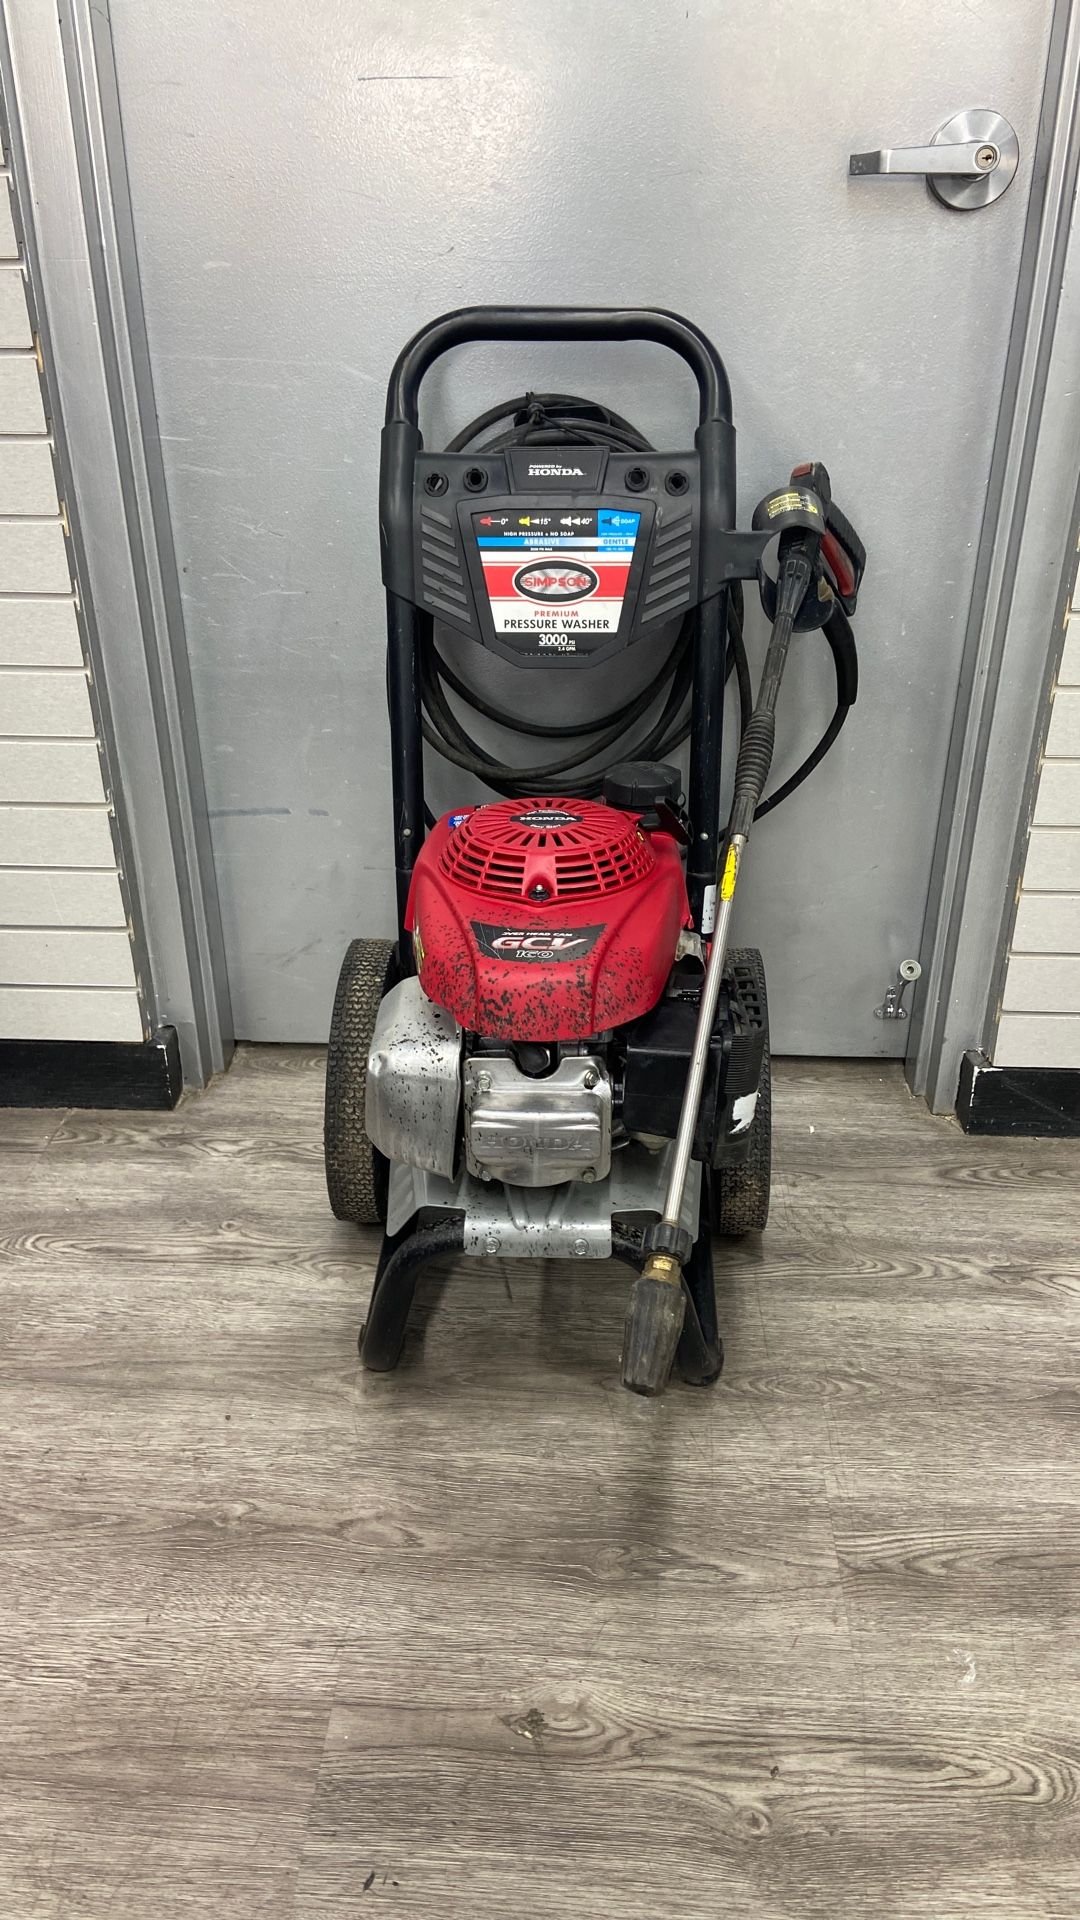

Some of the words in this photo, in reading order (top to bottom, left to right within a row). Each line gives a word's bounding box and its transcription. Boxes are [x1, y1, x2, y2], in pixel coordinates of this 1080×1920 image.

[528, 468, 584, 476] HONDA
[524, 577, 587, 588] SIMPSON
[504, 619, 557, 629] PRESSURE
[562, 619, 610, 629] WASHER
[538, 634, 568, 645] 3000
[491, 936, 588, 950] GCV
[515, 950, 554, 958] 160
[480, 1134, 591, 1151] HONDA
